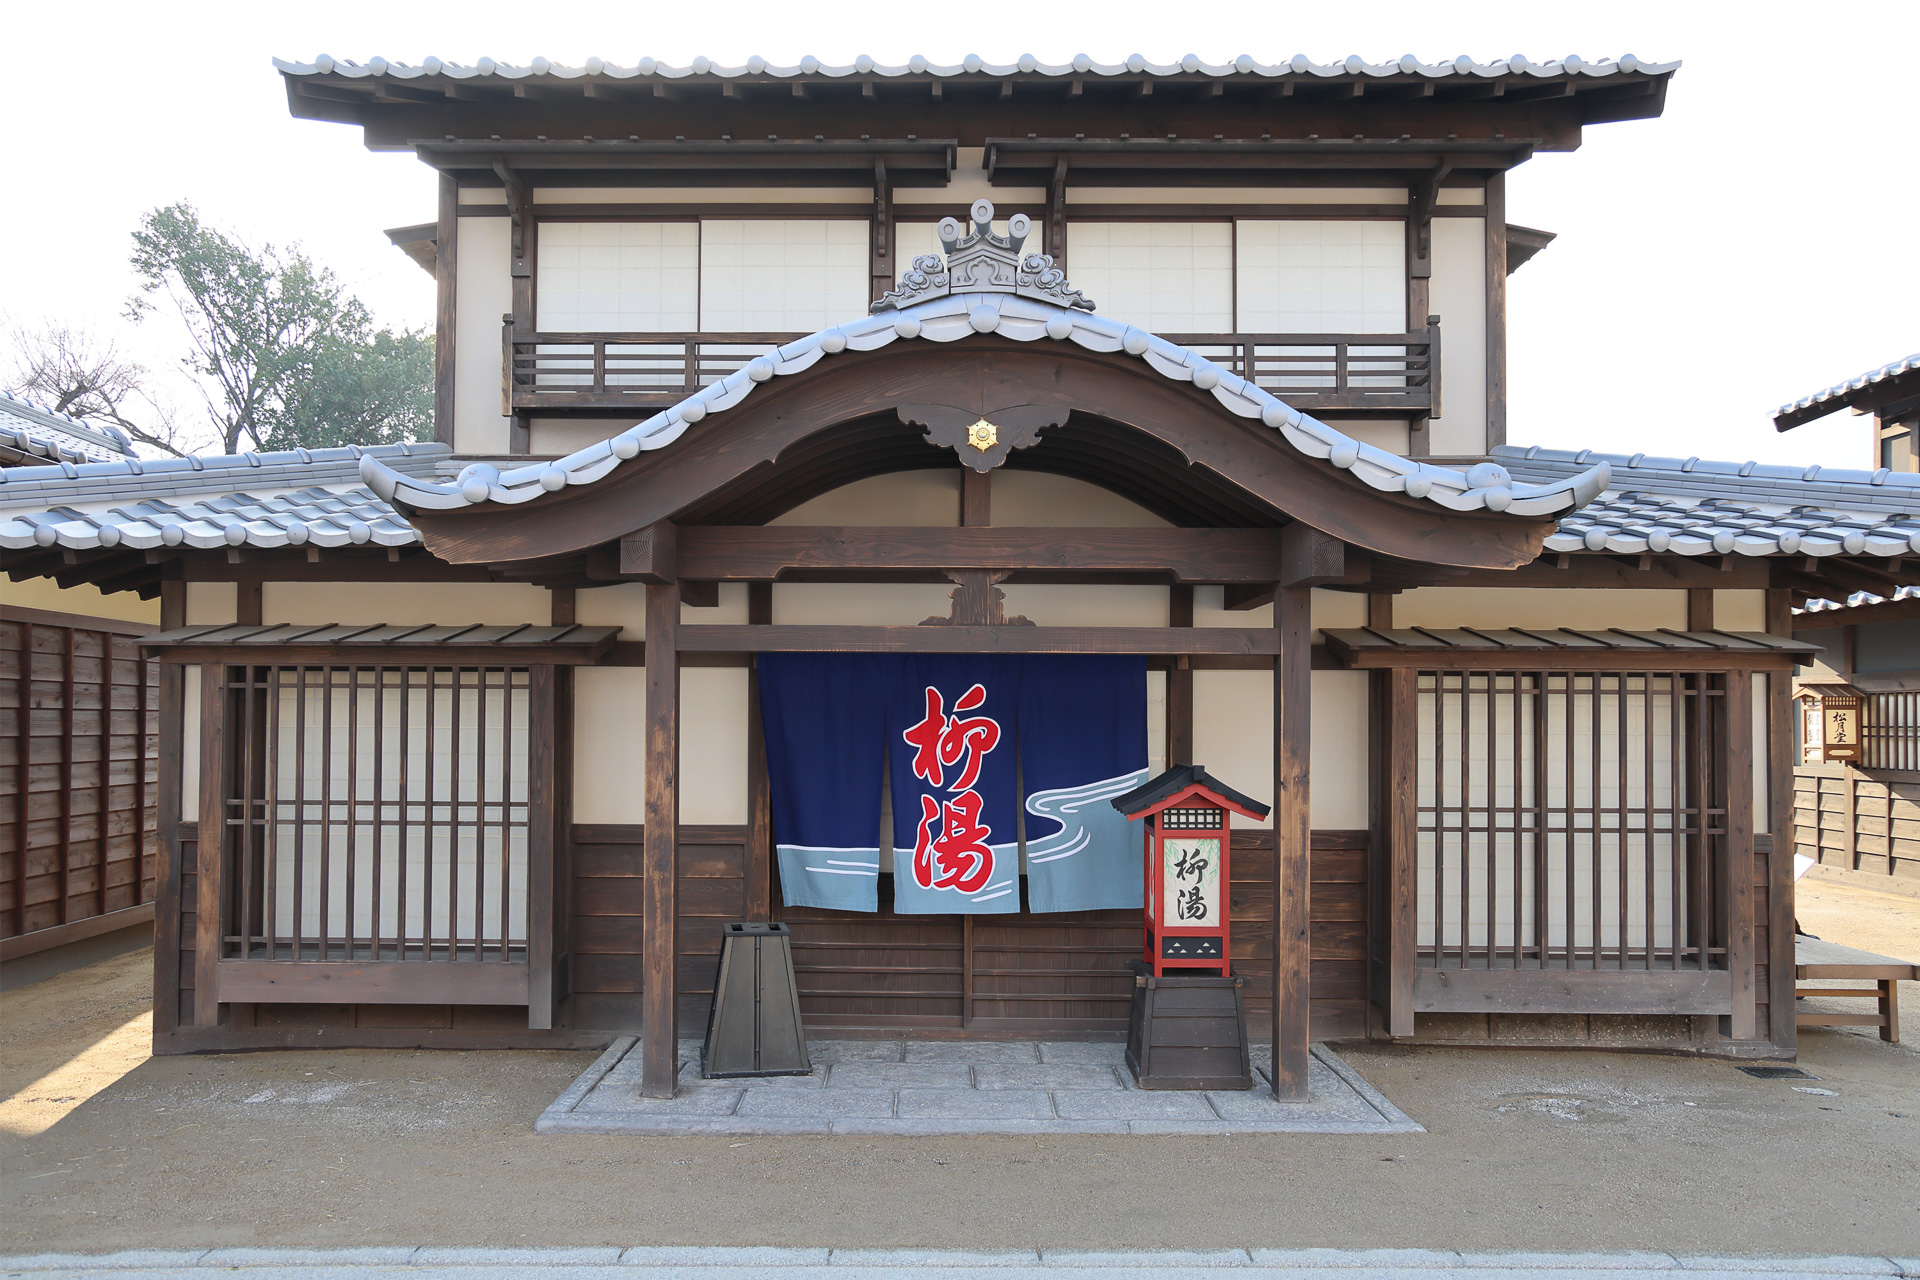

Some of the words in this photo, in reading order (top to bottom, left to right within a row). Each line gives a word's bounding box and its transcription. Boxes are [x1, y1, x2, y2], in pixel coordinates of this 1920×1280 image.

[1833, 711, 1847, 743] 松月堂
[903, 684, 1001, 895] 柳湯
[1174, 848, 1208, 920] 柳湯
